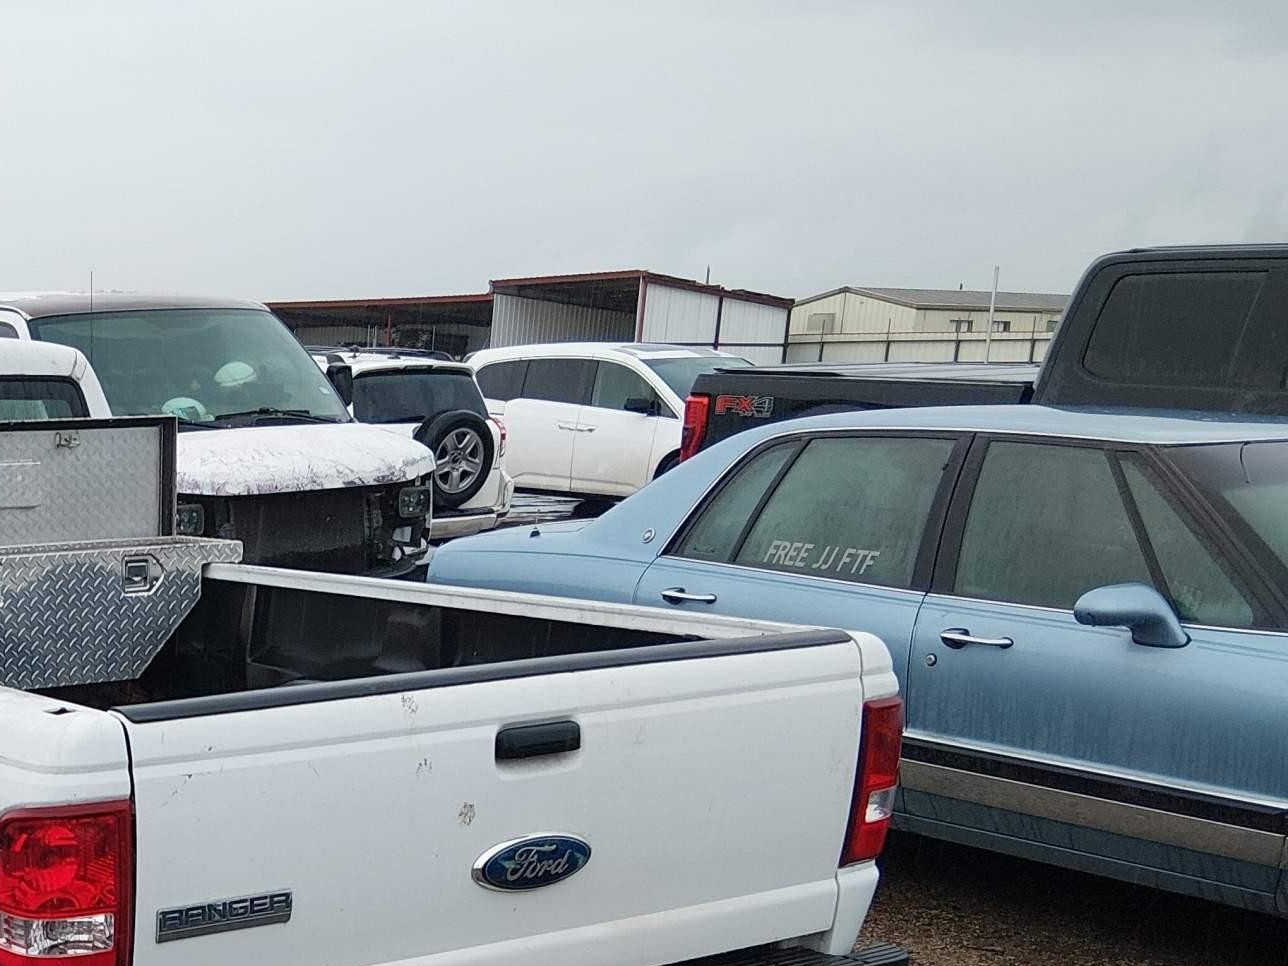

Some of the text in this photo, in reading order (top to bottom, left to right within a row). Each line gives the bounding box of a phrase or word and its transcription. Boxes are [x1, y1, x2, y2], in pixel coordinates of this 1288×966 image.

[715, 394, 774, 416] FX4
[763, 540, 880, 575] FREE JJ FTF
[507, 843, 573, 881] Ford
[159, 892, 293, 930] RANGER
